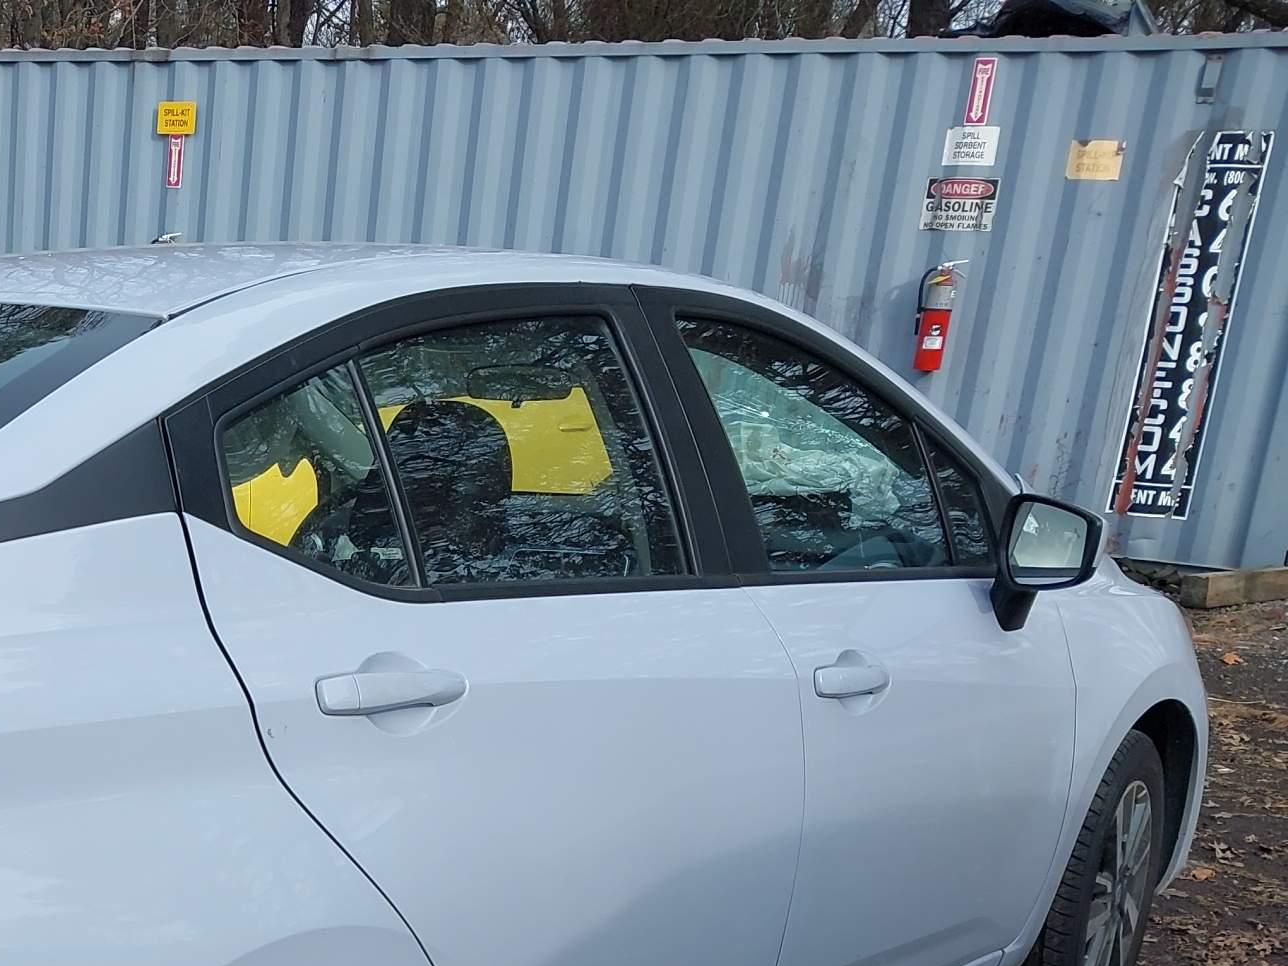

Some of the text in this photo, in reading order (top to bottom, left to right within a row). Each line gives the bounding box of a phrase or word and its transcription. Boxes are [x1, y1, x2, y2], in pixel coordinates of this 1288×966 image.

[163, 108, 191, 117] SPILL-KIT
[164, 119, 188, 128] STATION
[962, 131, 981, 139] SPILL
[952, 151, 985, 160] STORAGE
[926, 201, 993, 213] GASOLINE
[935, 221, 954, 229] OPEN
[957, 222, 988, 230] FLAMES
